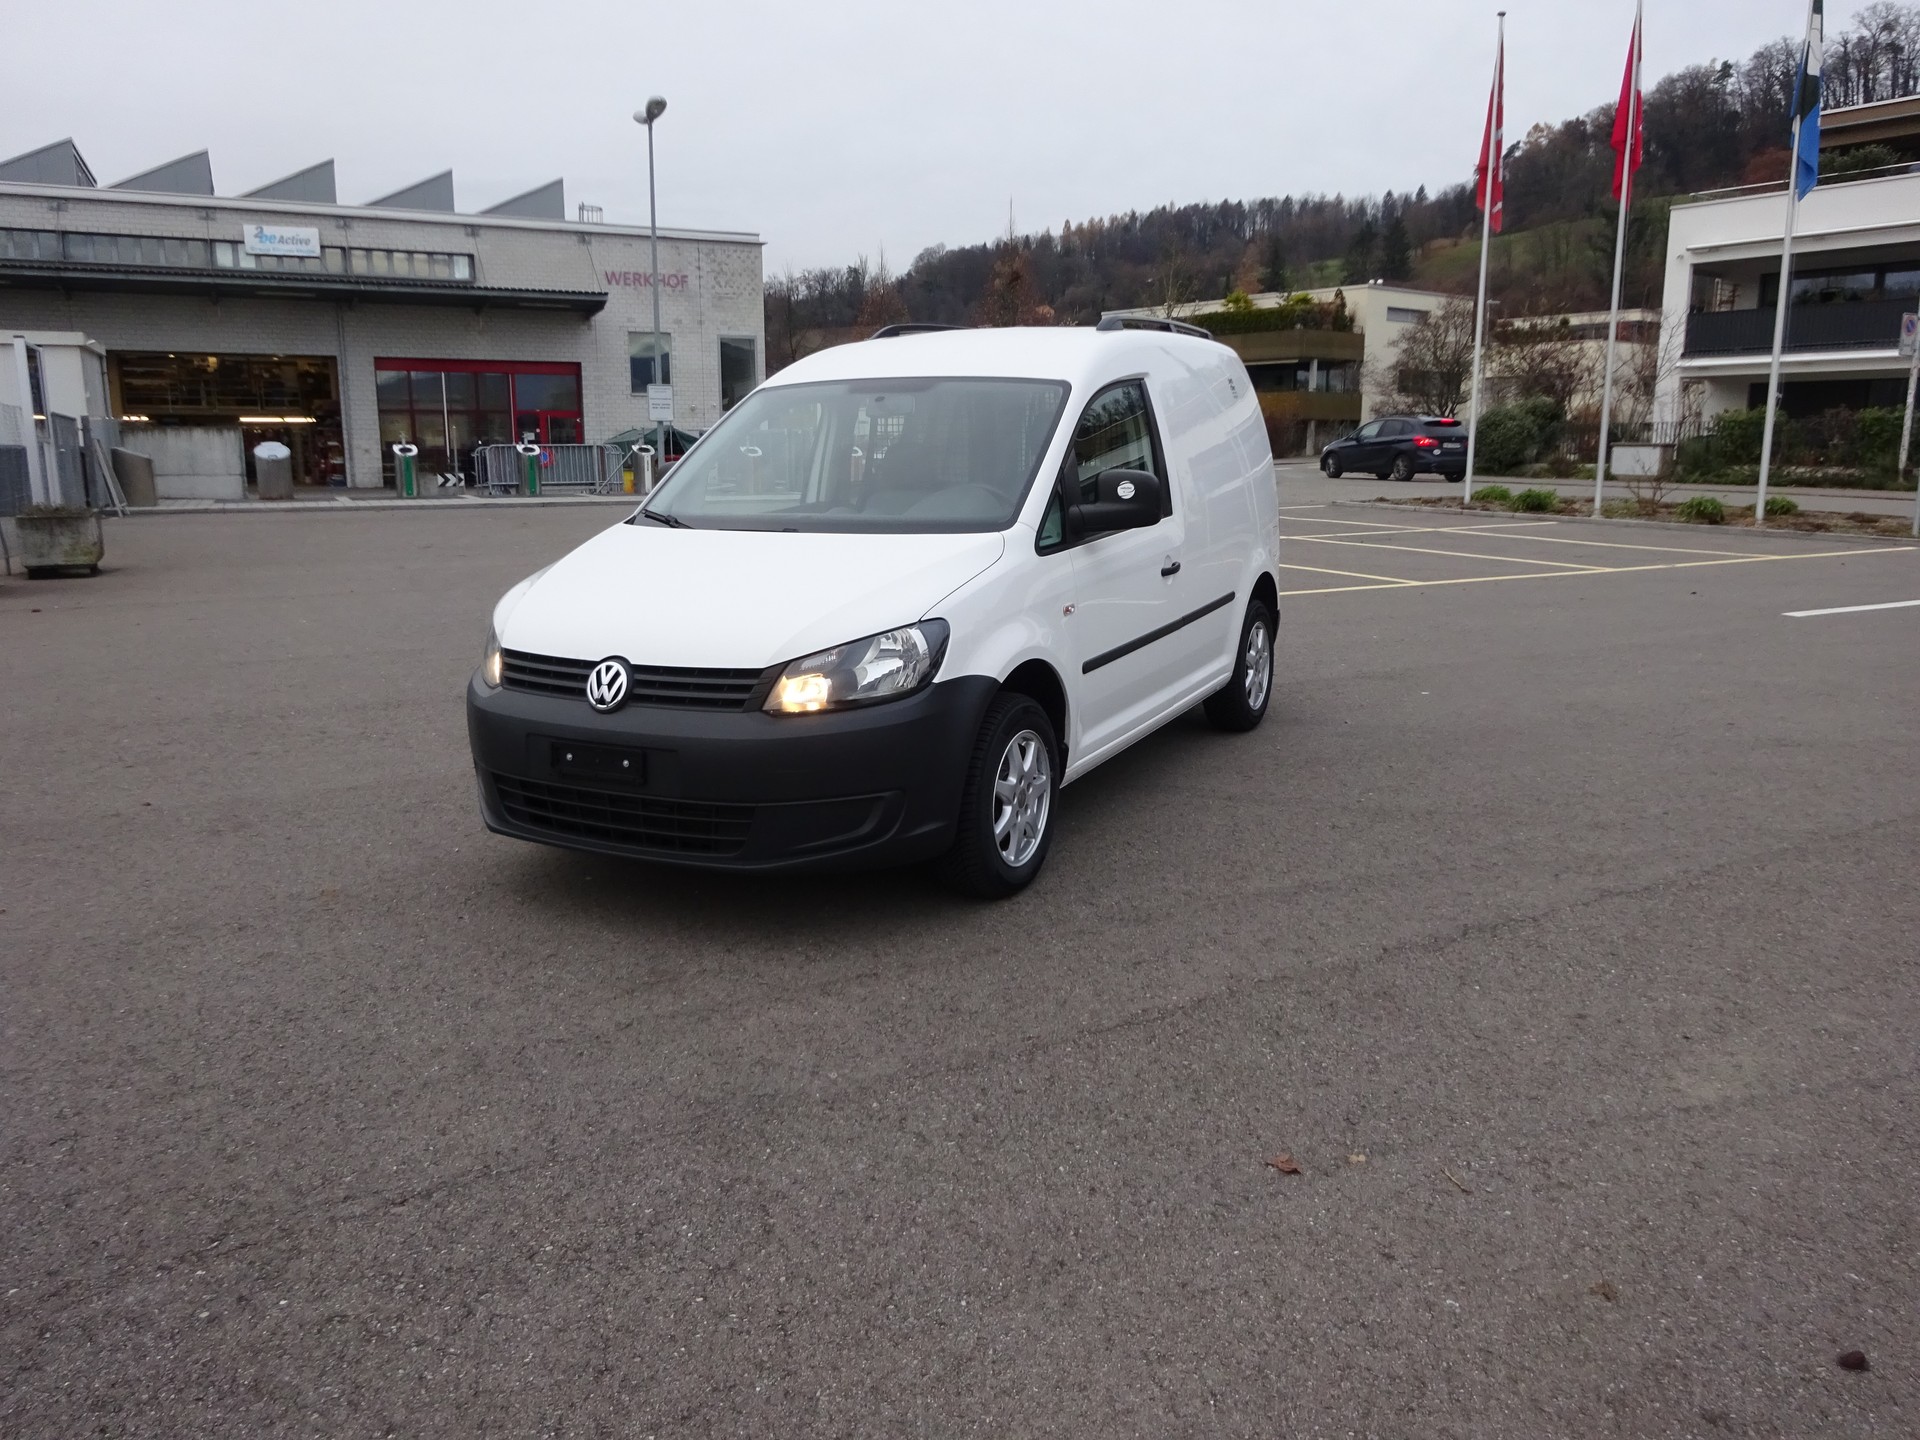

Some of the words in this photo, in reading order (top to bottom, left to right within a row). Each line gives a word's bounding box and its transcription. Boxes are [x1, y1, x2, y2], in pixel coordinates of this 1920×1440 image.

[278, 234, 311, 246] Active
[604, 270, 689, 289] WERKHOF
[587, 661, 628, 709] VW
